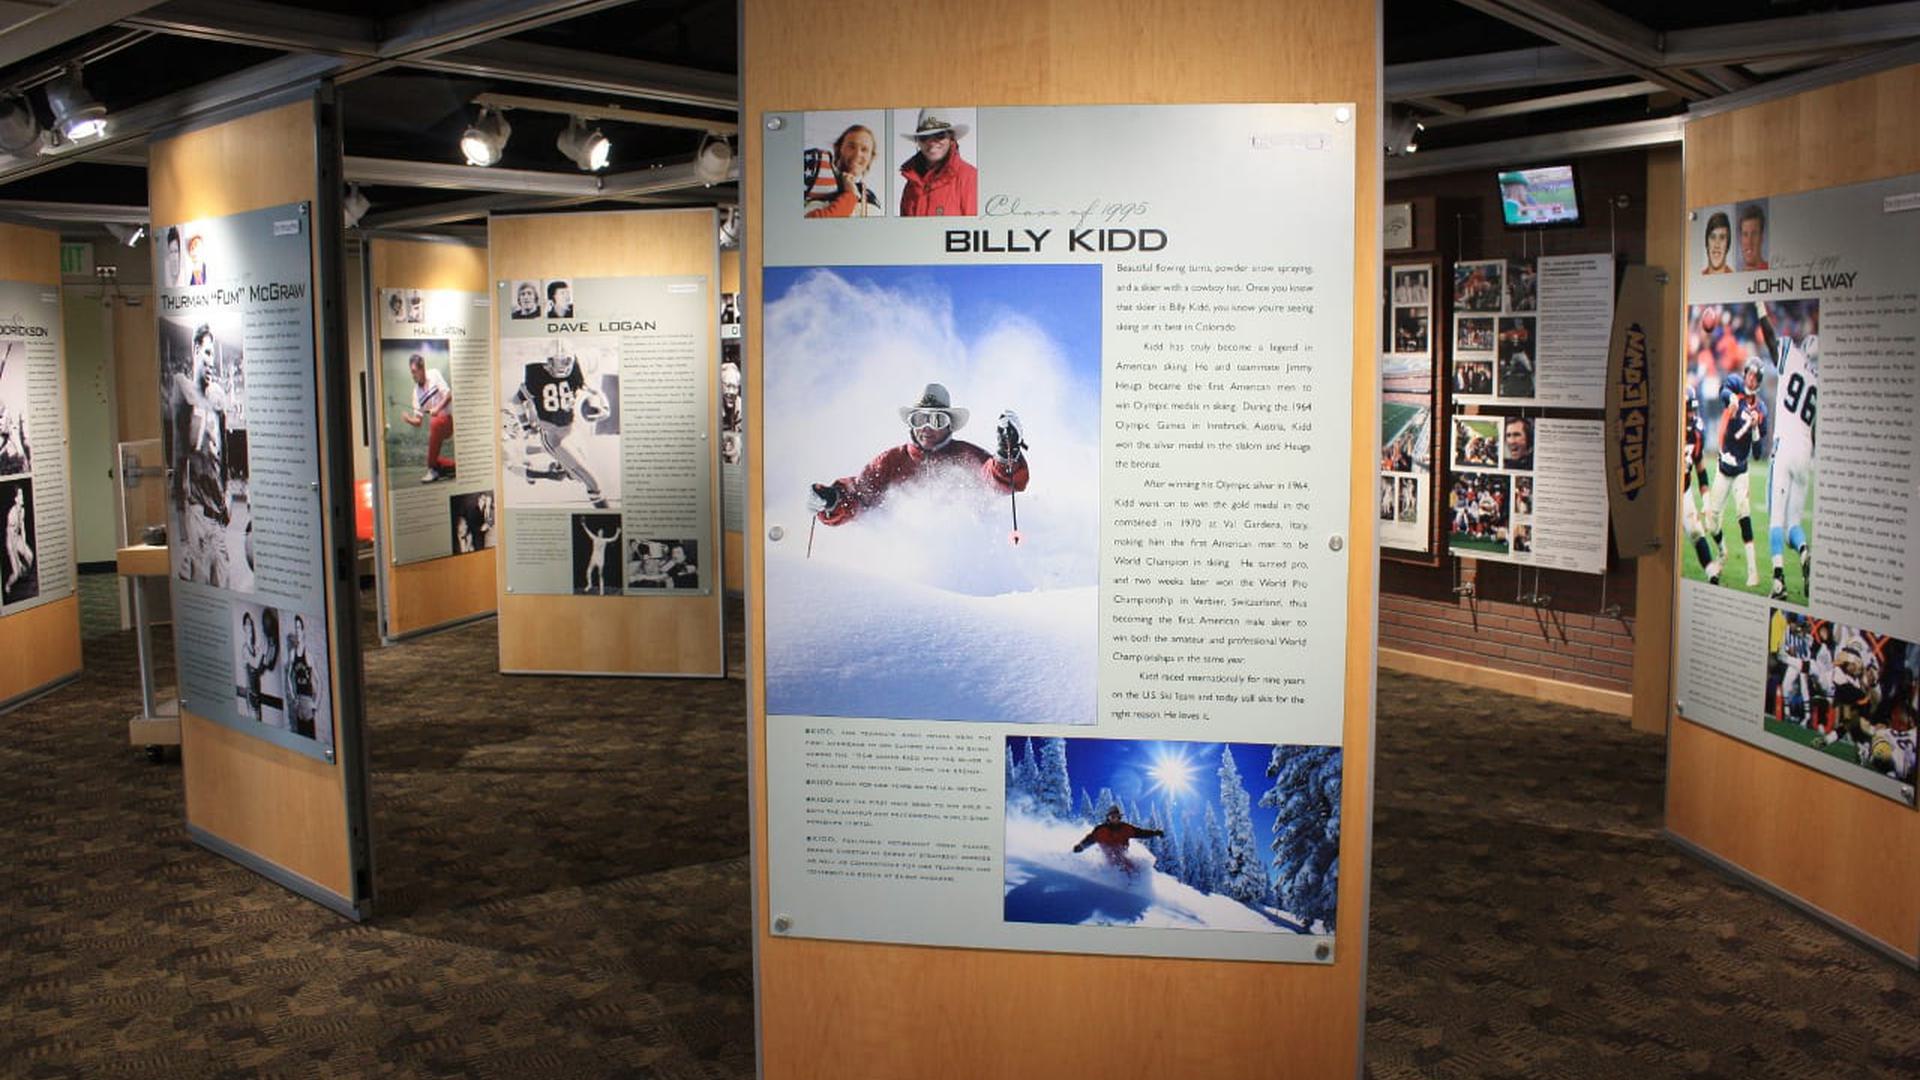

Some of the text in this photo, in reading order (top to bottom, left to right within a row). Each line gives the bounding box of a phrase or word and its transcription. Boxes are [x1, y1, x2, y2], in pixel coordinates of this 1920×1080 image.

[985, 194, 1150, 227] Class of 1995
[946, 229, 1168, 252] BILLY KIDD
[1117, 263, 1153, 272] Beautiful
[1156, 263, 1186, 275] flowing
[1214, 264, 1248, 275] powder
[1116, 282, 1132, 292] and
[1141, 283, 1161, 292] skier
[1190, 283, 1224, 295] cowboy
[1246, 283, 1270, 293] Once
[1271, 286, 1288, 295] you
[1289, 284, 1314, 293] know
[1748, 272, 1858, 294] JOHN ELWAY
[161, 294, 209, 310] THURMAN
[1116, 302, 1133, 311] that
[1136, 302, 1157, 311] skier
[1169, 302, 1185, 314] Billy
[1213, 305, 1230, 314] you
[1231, 303, 1255, 312] know
[1287, 303, 1314, 315] seeing
[548, 320, 656, 332] DAVE LOGAN
[1116, 322, 1139, 333] skiing
[1165, 322, 1182, 331] best
[1143, 342, 1298, 354] Kidd has truly become legend
[1116, 361, 1157, 370] American
[1195, 362, 1208, 371] He
[1286, 363, 1312, 375] Jimmy
[1148, 381, 1182, 390] became
[1187, 382, 1202, 391] the
[1208, 382, 1225, 391] first
[1230, 382, 1271, 391] American
[542, 381, 574, 412] 88
[1784, 372, 1818, 426] 96
[1133, 400, 1169, 412] Olympic
[1170, 401, 1200, 410] medals
[1242, 402, 1272, 413] During
[1274, 402, 1288, 411] the
[1292, 402, 1312, 412] 1964
[1115, 420, 1151, 432] Olympic
[1292, 422, 1312, 432] Kidd
[1137, 440, 1151, 449] the
[1178, 440, 1204, 449] medal
[1218, 441, 1233, 450] the
[1235, 441, 1262, 450] slalom
[1265, 442, 1281, 451] and
[1616, 410, 1645, 494] GOLD
[1115, 459, 1128, 468] the
[1143, 479, 1166, 488] After
[1168, 479, 1200, 491] winning
[1215, 480, 1251, 492] Olympic
[1114, 498, 1310, 512] Kidd gold medal the
[1114, 517, 1157, 526] combined
[1181, 518, 1201, 528] 1970
[1223, 519, 1237, 528] Val
[1114, 537, 1309, 550] making the first American be
[1114, 556, 1141, 565] World
[1145, 557, 1189, 569] Champion
[1241, 559, 1253, 568] He
[1258, 559, 1287, 568] turned
[1190, 577, 1209, 586] later
[1240, 578, 1254, 587] the
[1260, 578, 1287, 588] World
[1292, 579, 1308, 588] Pro
[1114, 595, 1174, 607] Championship
[1289, 599, 1308, 608] thus
[1112, 614, 1292, 627] becoming the first American skier
[1154, 634, 1307, 647] the amateur and professional World
[1112, 653, 1175, 664] Championships
[1187, 654, 1201, 663] the
[1139, 672, 1159, 681] Kidd
[1161, 672, 1184, 682] raced
[1247, 674, 1261, 684] for
[1283, 678, 1305, 687] years
[1125, 690, 1305, 704] the Team and today skis for the
[1111, 709, 1131, 720] right
[1163, 710, 1177, 719] He
[1178, 711, 1200, 720] loves
